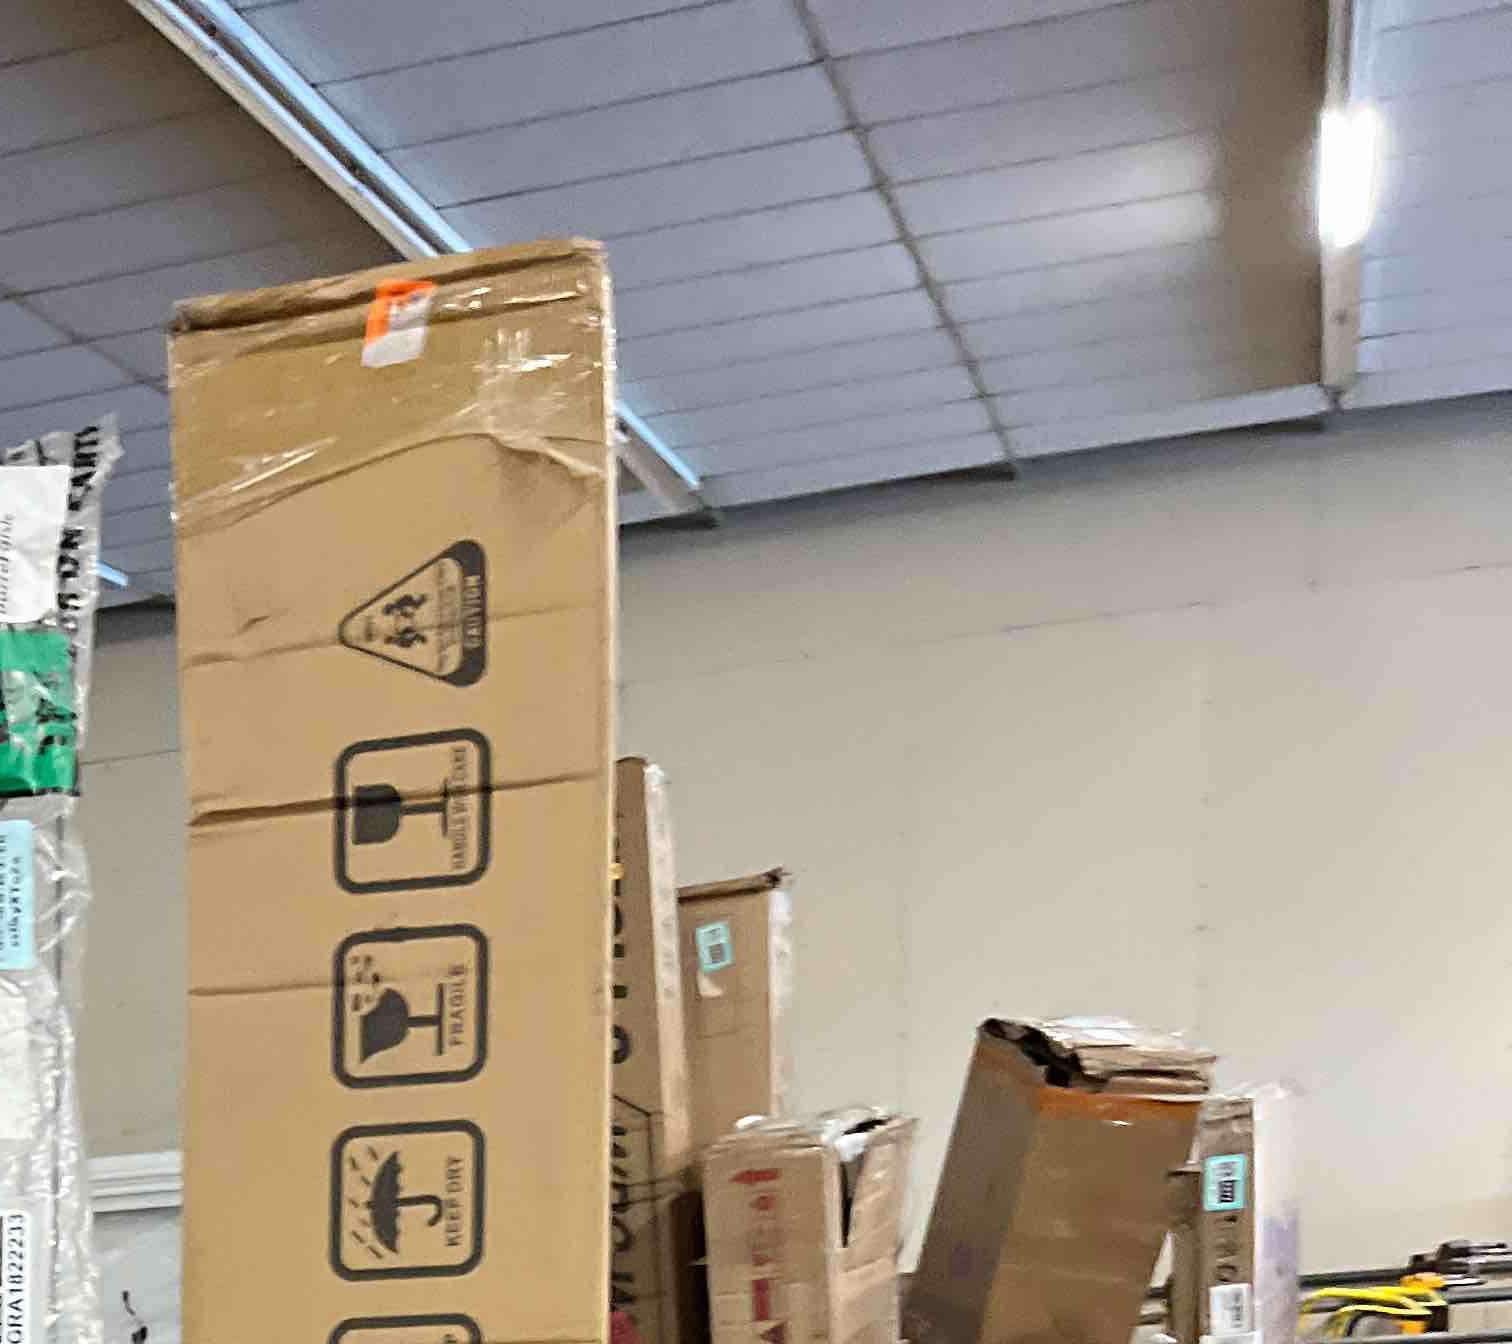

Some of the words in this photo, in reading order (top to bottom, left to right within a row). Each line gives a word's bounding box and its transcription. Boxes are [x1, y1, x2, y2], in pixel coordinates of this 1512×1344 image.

[449, 965, 466, 1045] FRAGILE
[448, 1156, 465, 1195] DRY
[445, 1198, 464, 1247] KEEP
